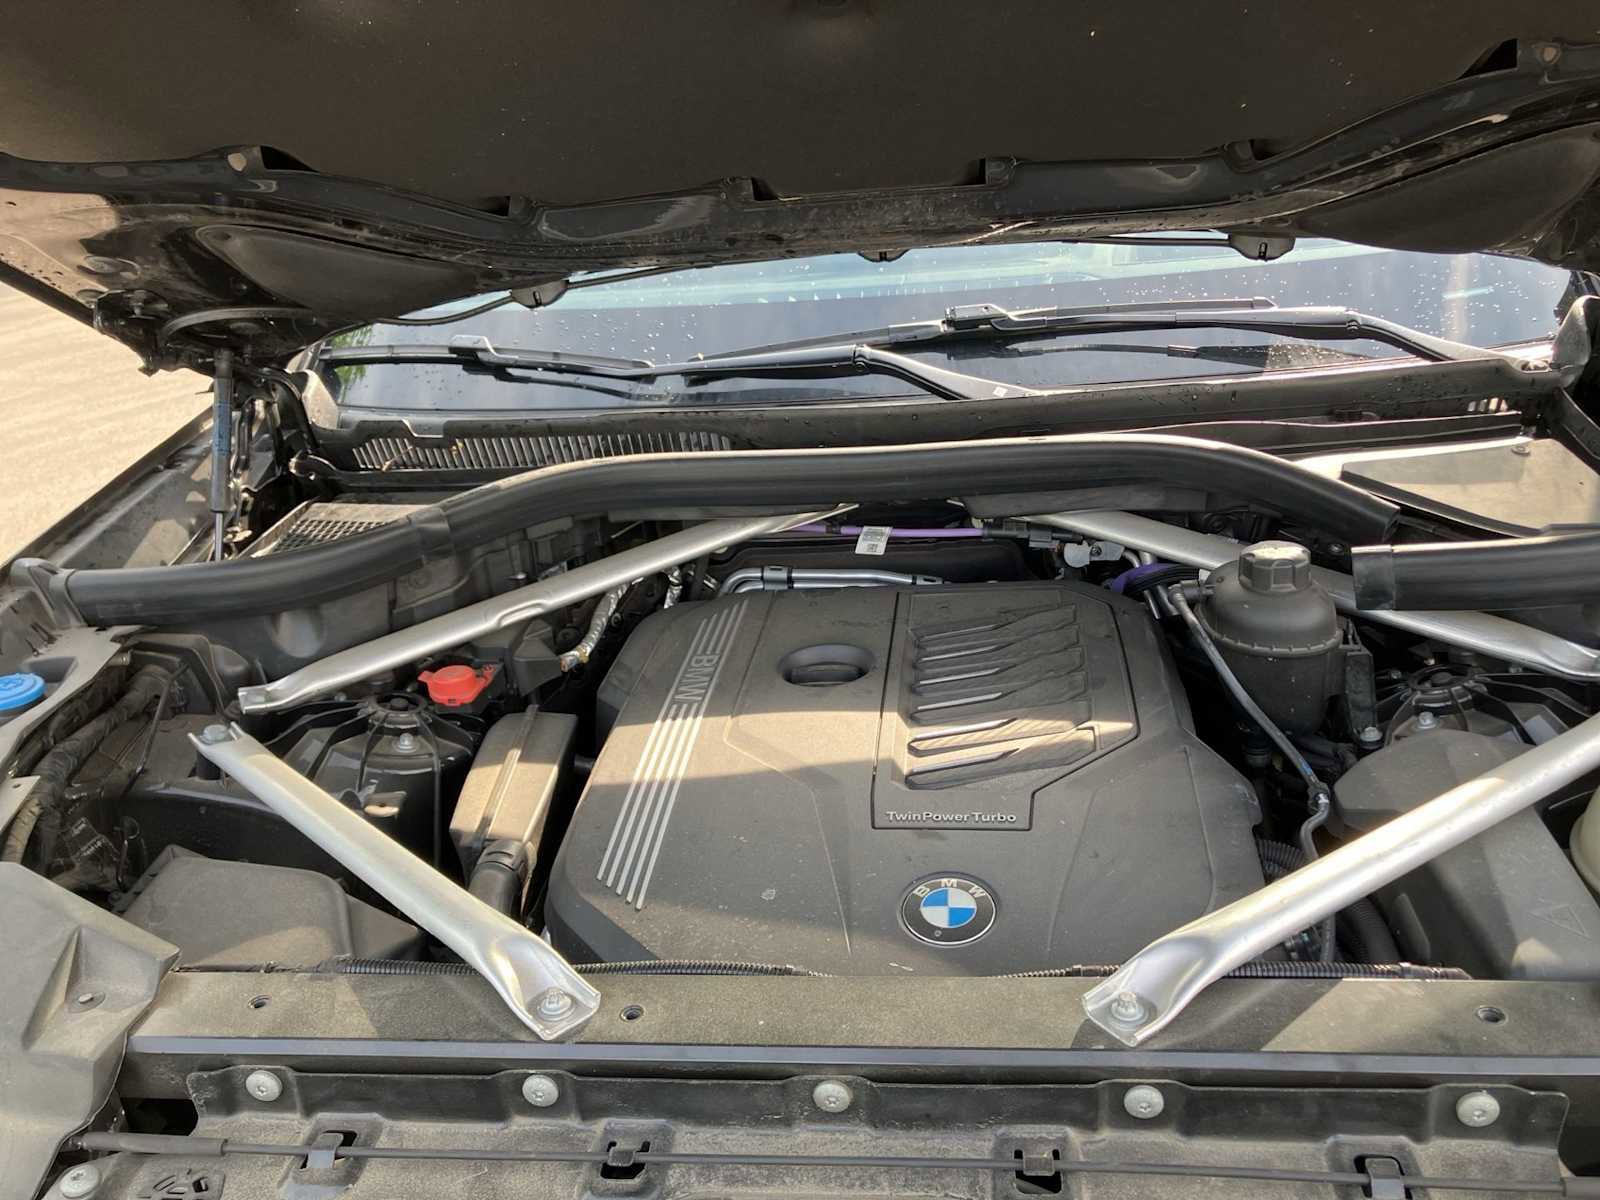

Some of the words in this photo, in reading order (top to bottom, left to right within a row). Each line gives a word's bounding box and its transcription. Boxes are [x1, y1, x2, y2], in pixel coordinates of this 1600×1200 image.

[673, 655, 720, 702] BMW
[971, 811, 1017, 823] Turbo
[912, 878, 985, 898] BMW
